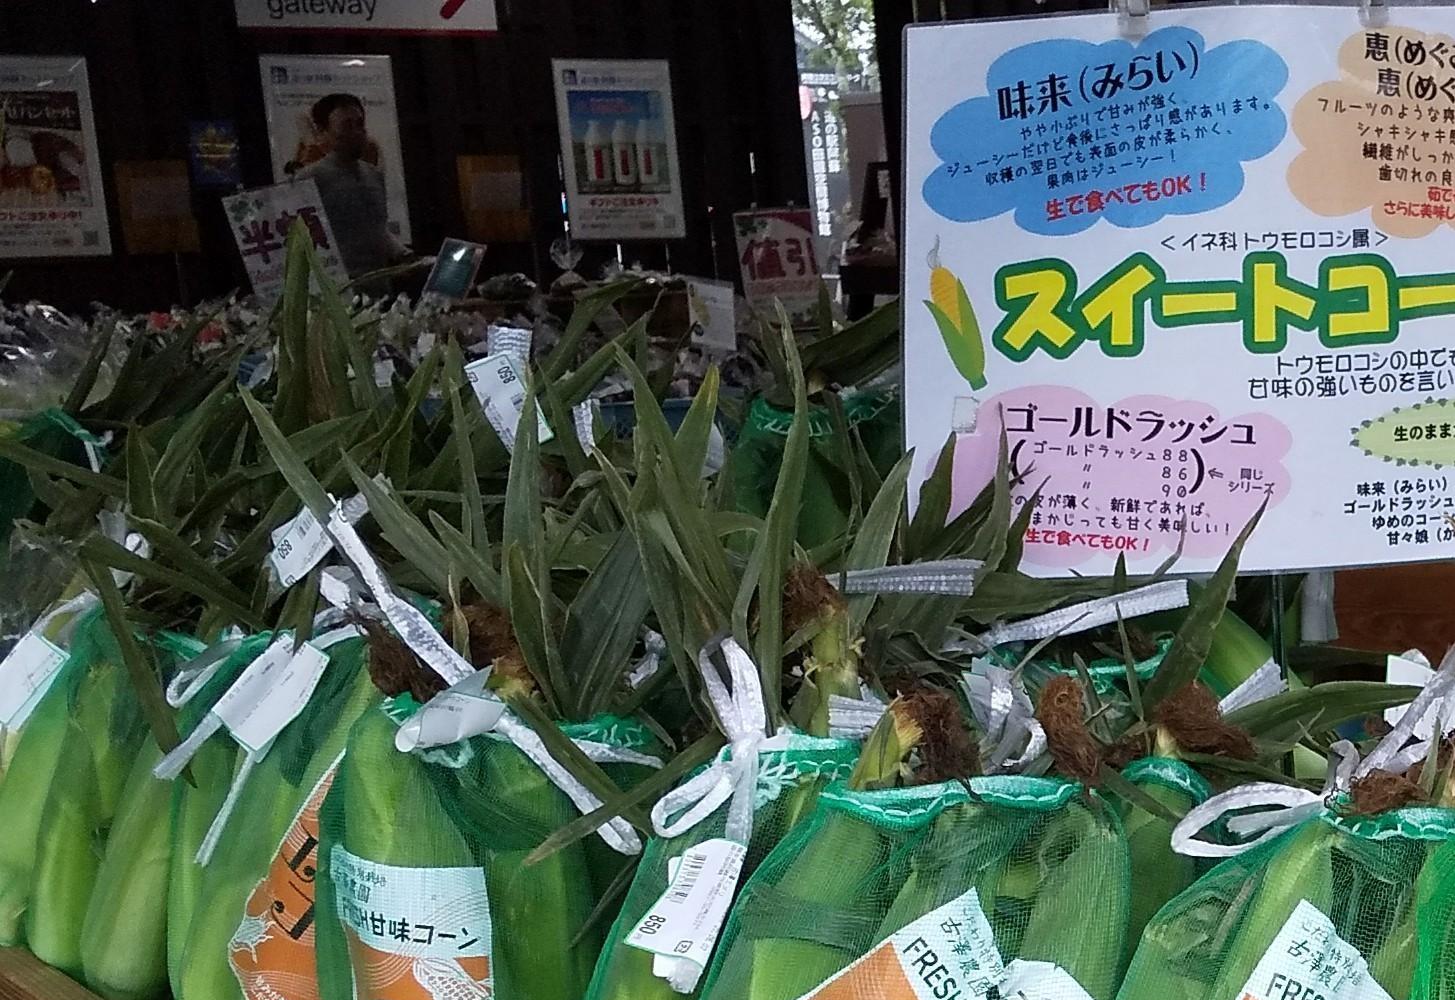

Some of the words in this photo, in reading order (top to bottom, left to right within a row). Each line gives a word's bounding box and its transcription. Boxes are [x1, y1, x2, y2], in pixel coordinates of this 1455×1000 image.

[267, 0, 377, 20] gateway
[997, 40, 1200, 121] 味来(みらい)
[1046, 149, 1178, 189] 果肉はジューシー!
[1045, 172, 1208, 222] 生で食べてもOK!
[1006, 403, 1257, 446] ゴールドラッシュ
[1239, 467, 1264, 482] 同じ
[639, 913, 667, 936] 850
